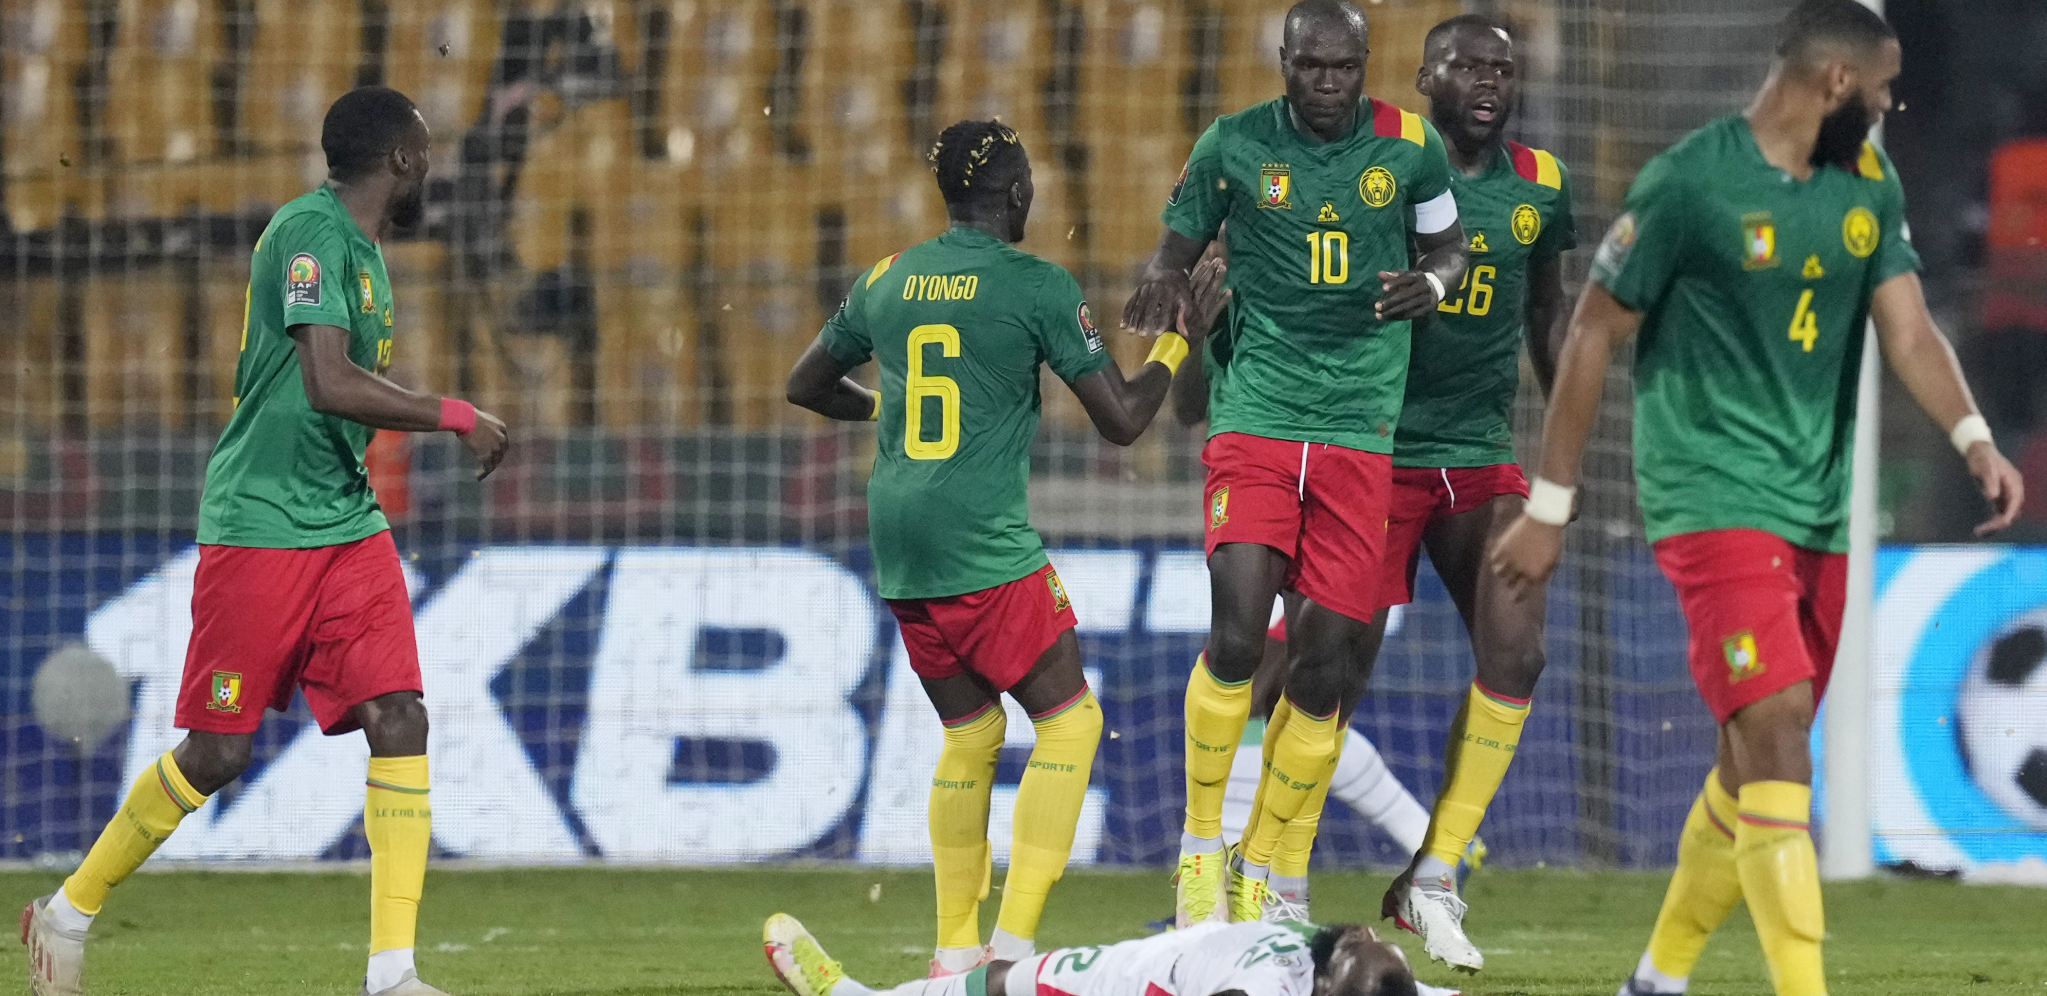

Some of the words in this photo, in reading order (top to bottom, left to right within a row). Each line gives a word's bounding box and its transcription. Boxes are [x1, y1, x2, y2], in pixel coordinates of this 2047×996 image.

[1306, 231, 1349, 284] 10
[291, 282, 313, 290] CAF
[902, 275, 979, 301] OYONGO
[1788, 288, 1819, 352] 4
[904, 323, 961, 460] 6
[85, 545, 1403, 864] 1XBE
[932, 778, 978, 789] SPORTIF
[1028, 760, 1077, 773] SPORTIF
